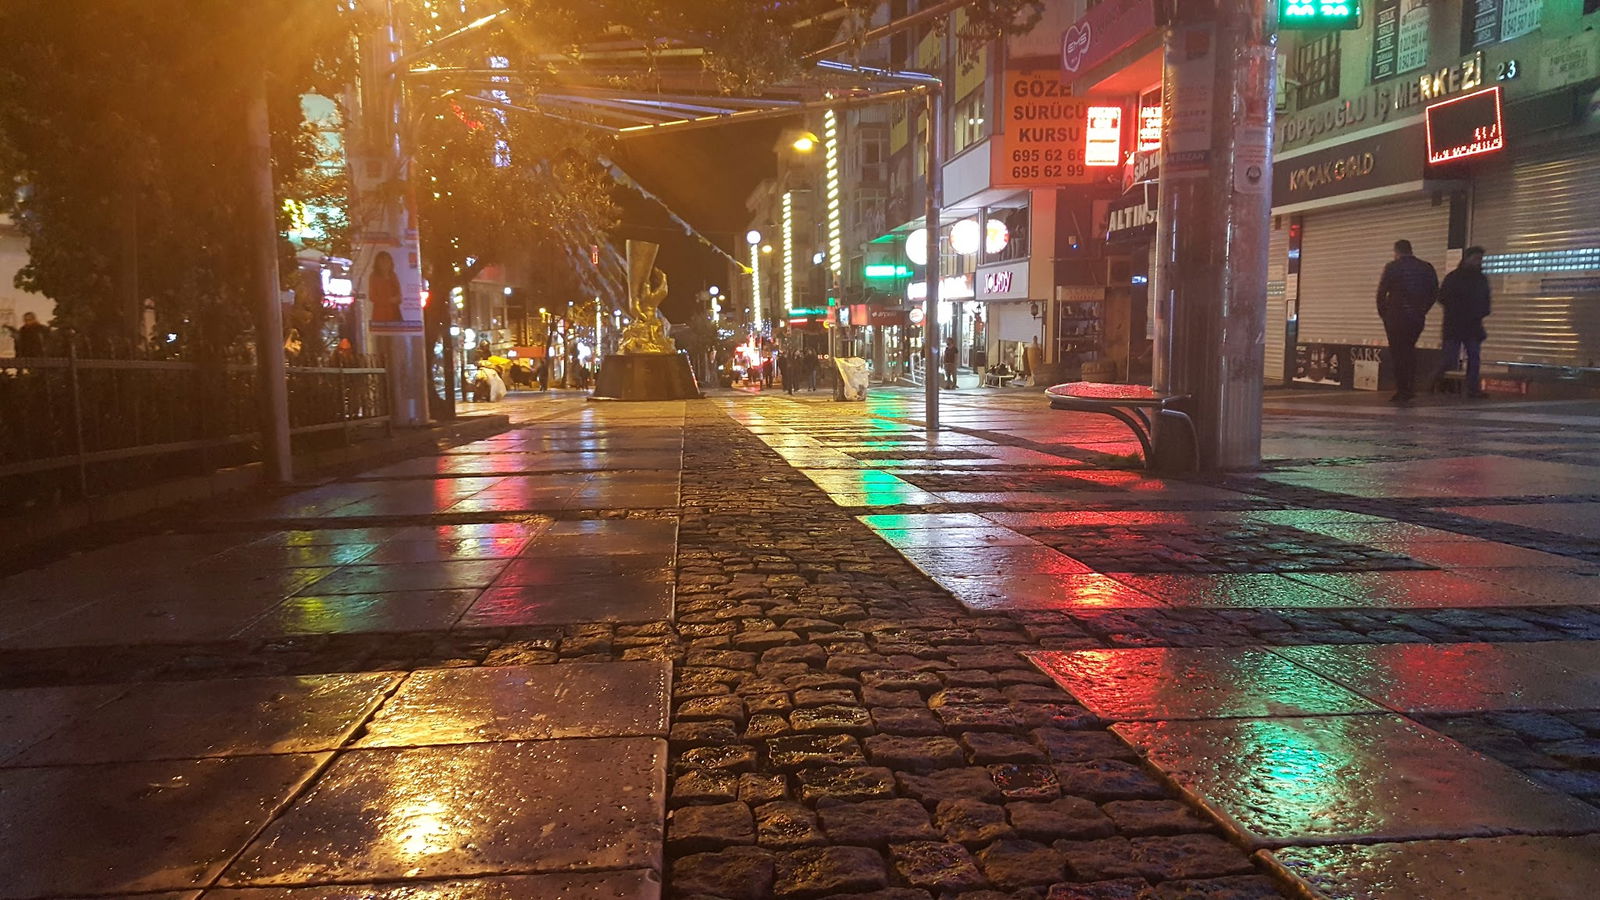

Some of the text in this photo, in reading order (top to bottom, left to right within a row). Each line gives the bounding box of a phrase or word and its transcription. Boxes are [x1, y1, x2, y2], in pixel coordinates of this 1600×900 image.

[1497, 59, 1517, 81] 23
[1395, 51, 1484, 110] MERKEZİ
[1013, 102, 1087, 121] SÜRÜCÜ
[1019, 128, 1080, 143] KURSU
[1012, 149, 1040, 162] 695
[1045, 149, 1062, 162] 62
[1012, 165, 1085, 178] 695 62 99
[1289, 151, 1375, 192] KOÇAK GOLD
